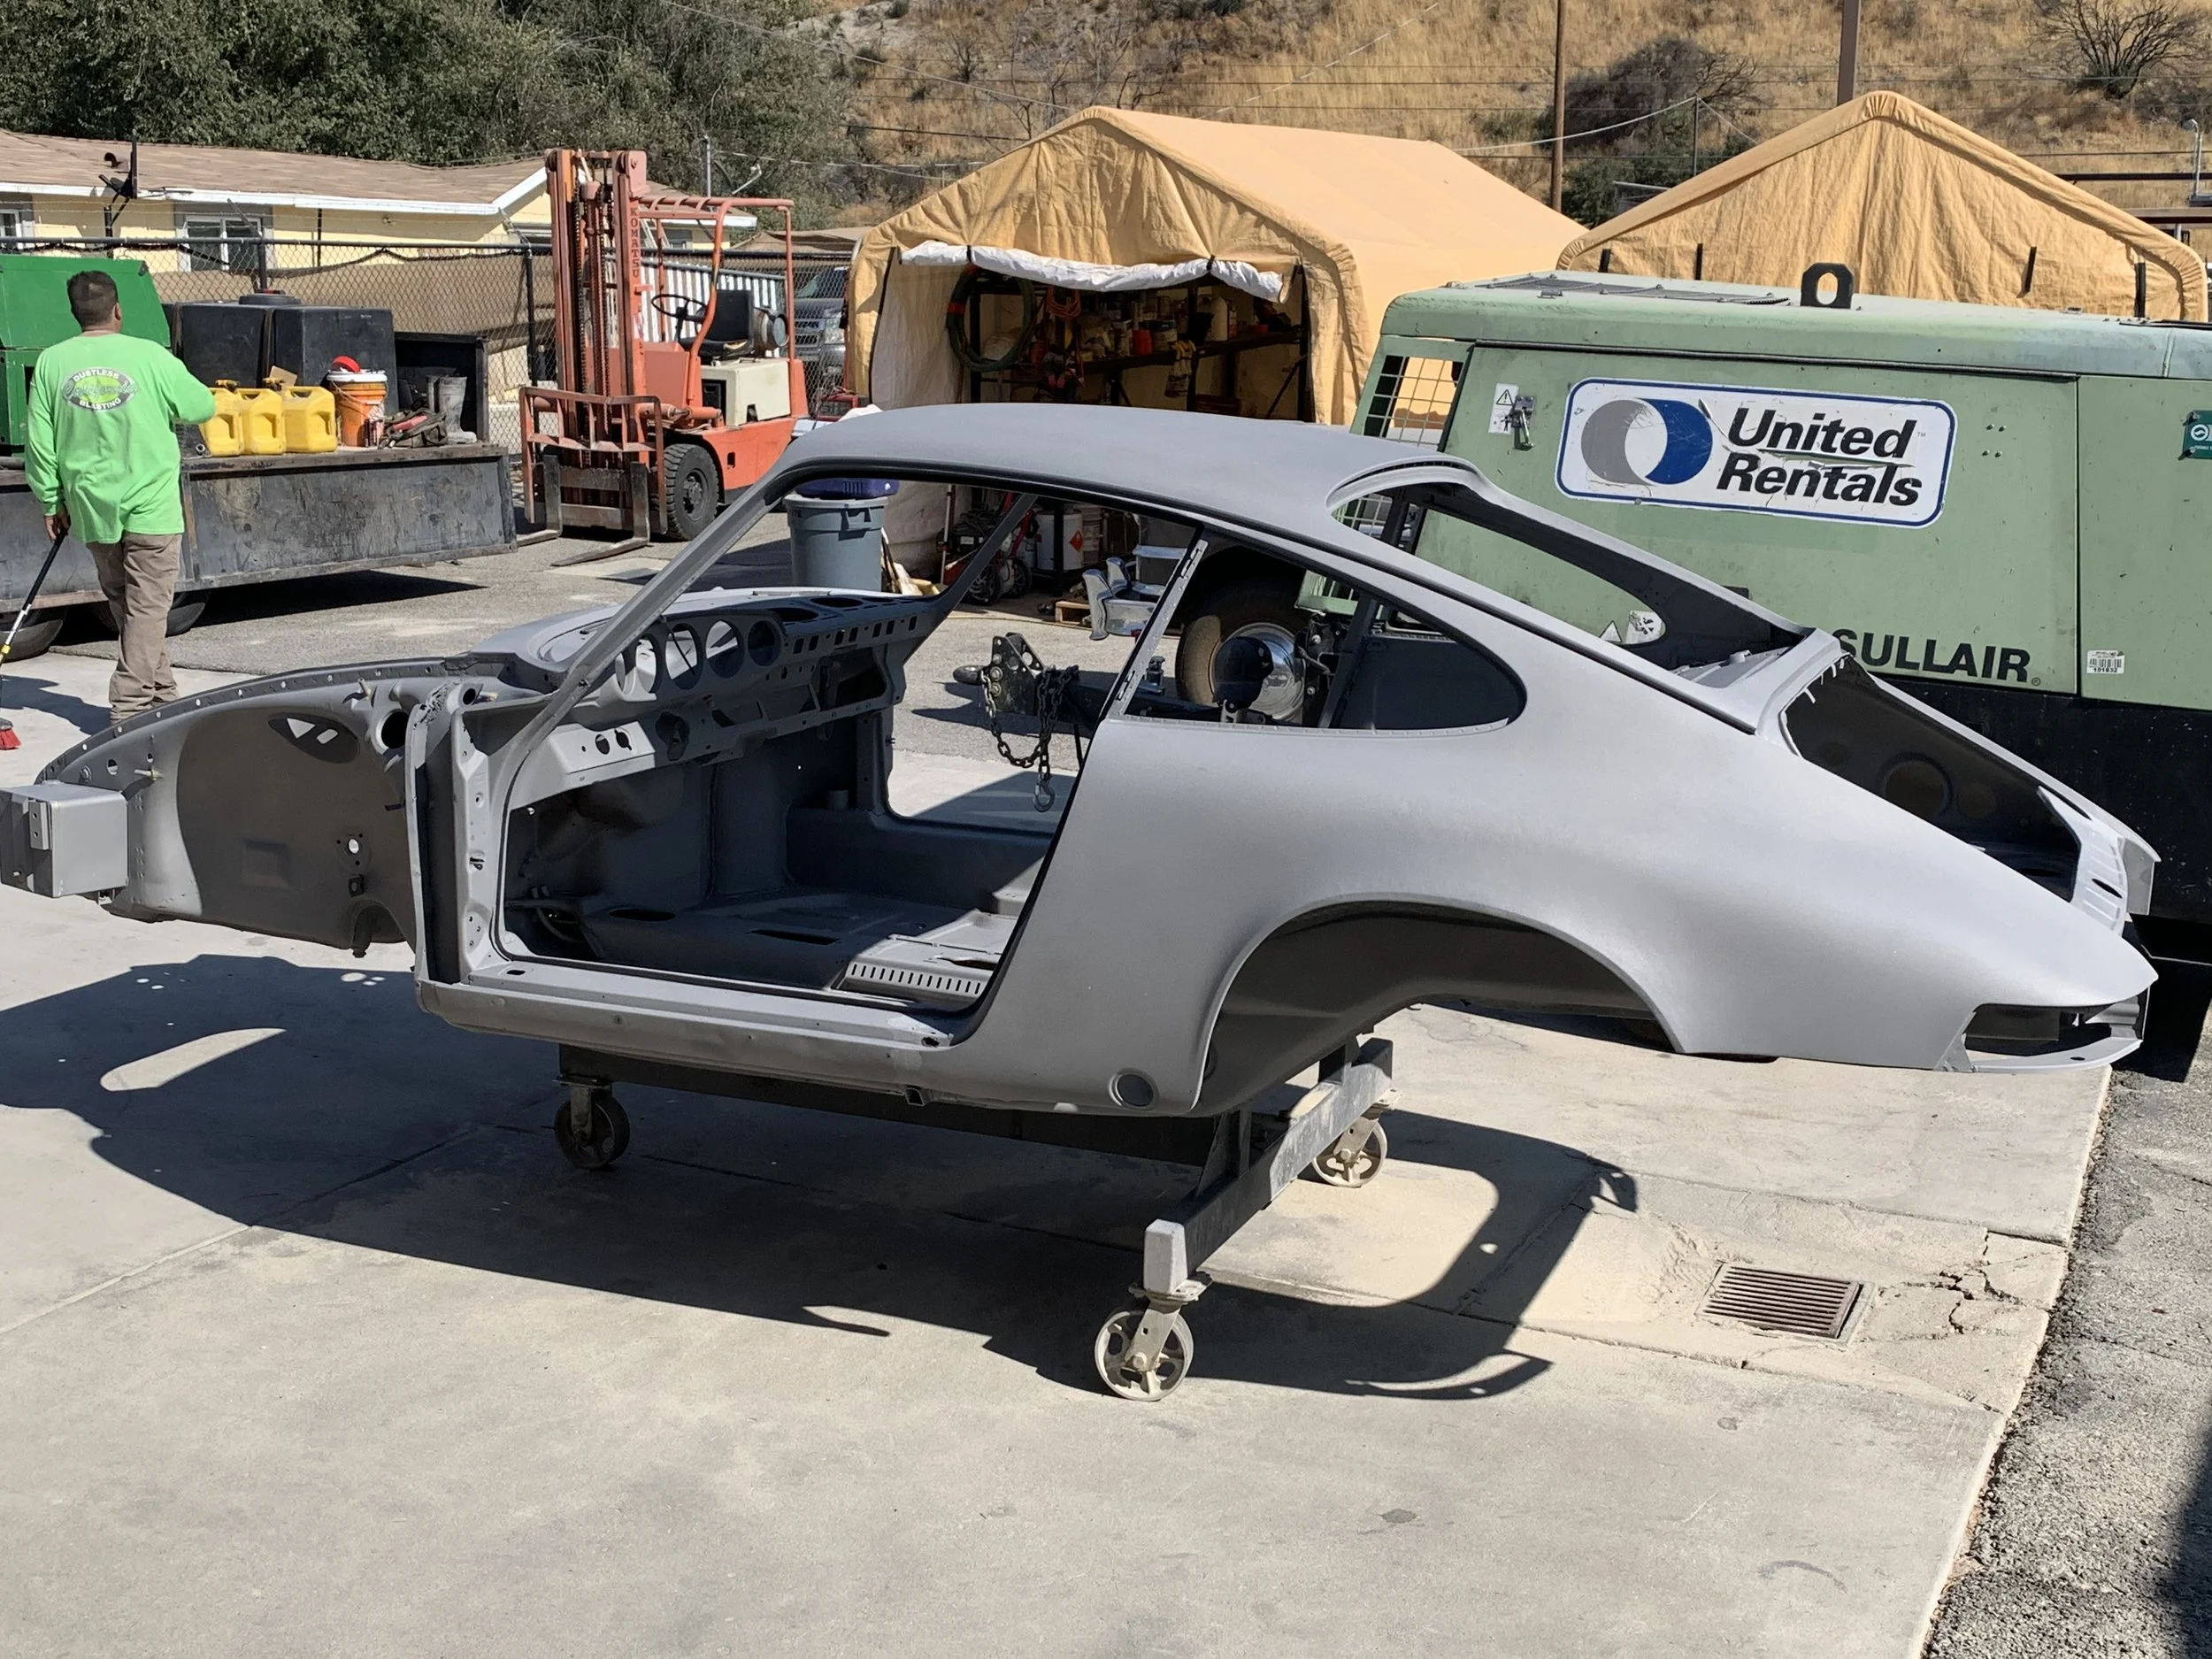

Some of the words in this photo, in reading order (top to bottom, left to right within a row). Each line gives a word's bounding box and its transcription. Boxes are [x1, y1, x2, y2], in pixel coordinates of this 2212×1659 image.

[629, 207, 640, 279] KOMATSU
[73, 368, 119, 382] DUSTLESS
[79, 397, 122, 410] BLASTING
[1728, 408, 1917, 458] United
[1717, 452, 1923, 506] Rentals
[1832, 628, 2031, 683] SULLAIR
